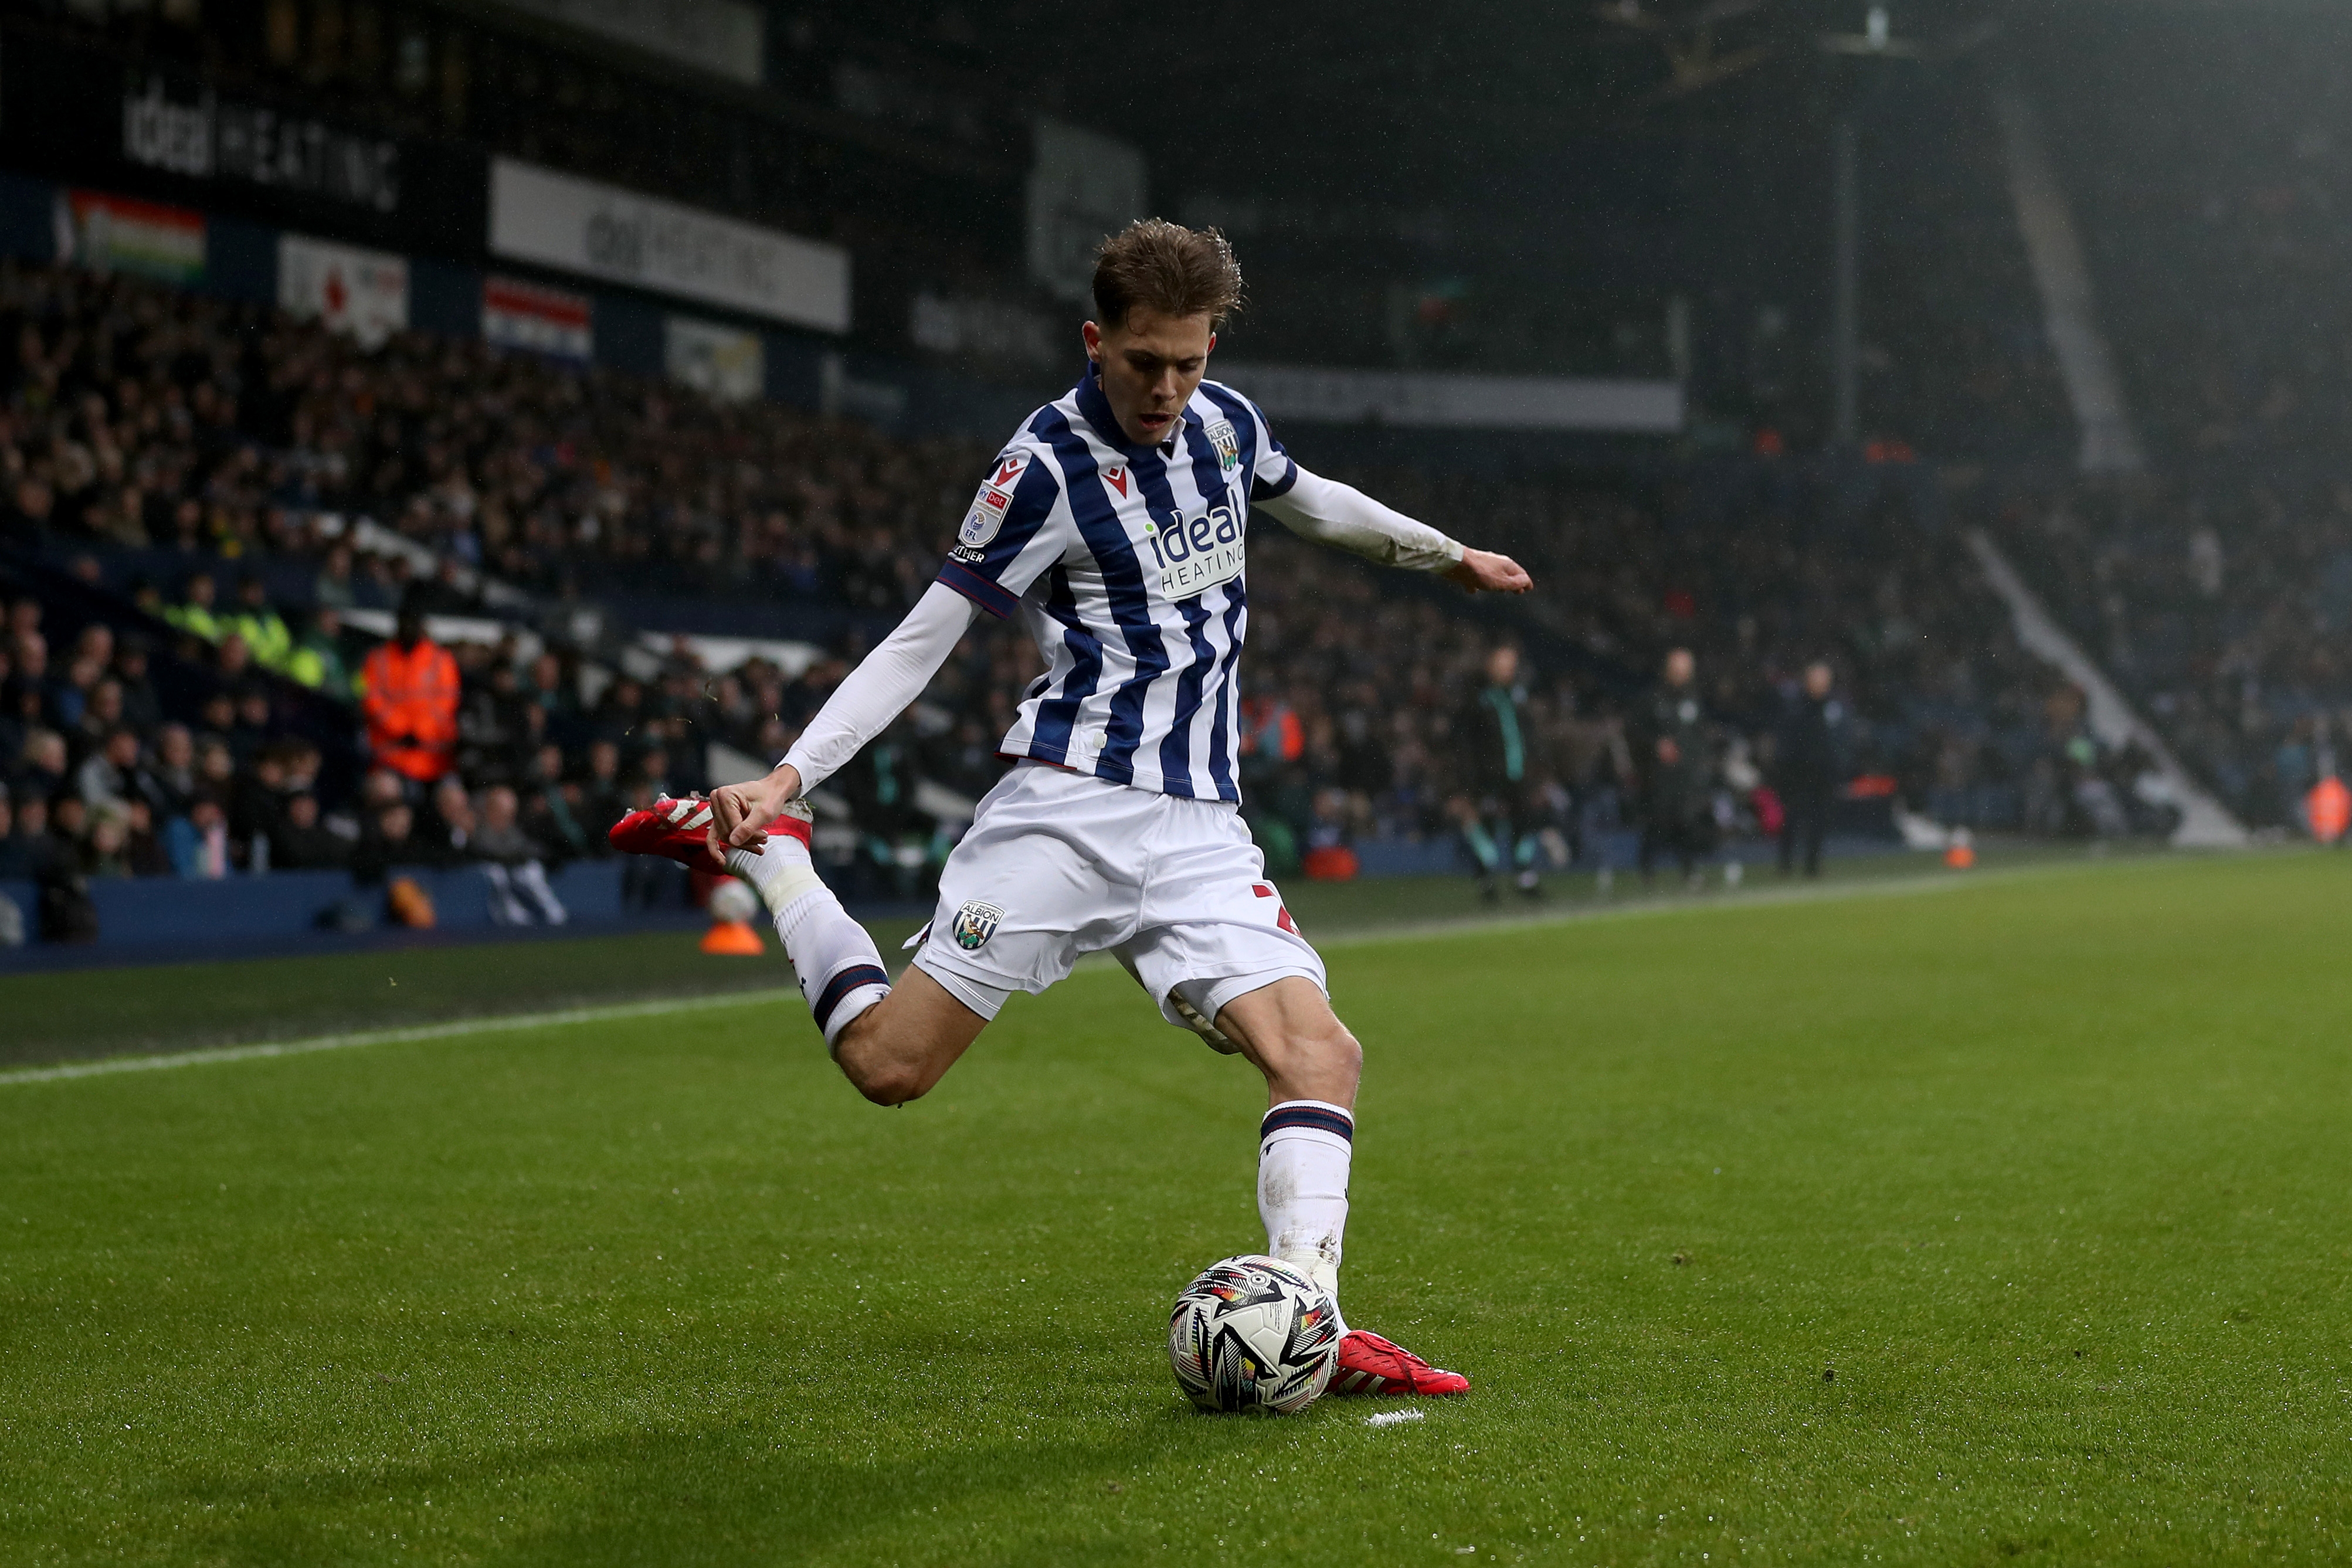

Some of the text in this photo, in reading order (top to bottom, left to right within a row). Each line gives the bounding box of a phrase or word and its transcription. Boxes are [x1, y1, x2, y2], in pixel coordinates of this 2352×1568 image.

[219, 107, 400, 213] HEATING
[988, 492, 1004, 506] bet
[965, 529, 976, 541] EFL
[1145, 489, 1243, 592] ideal HEATING
[962, 904, 999, 922] ALBION
